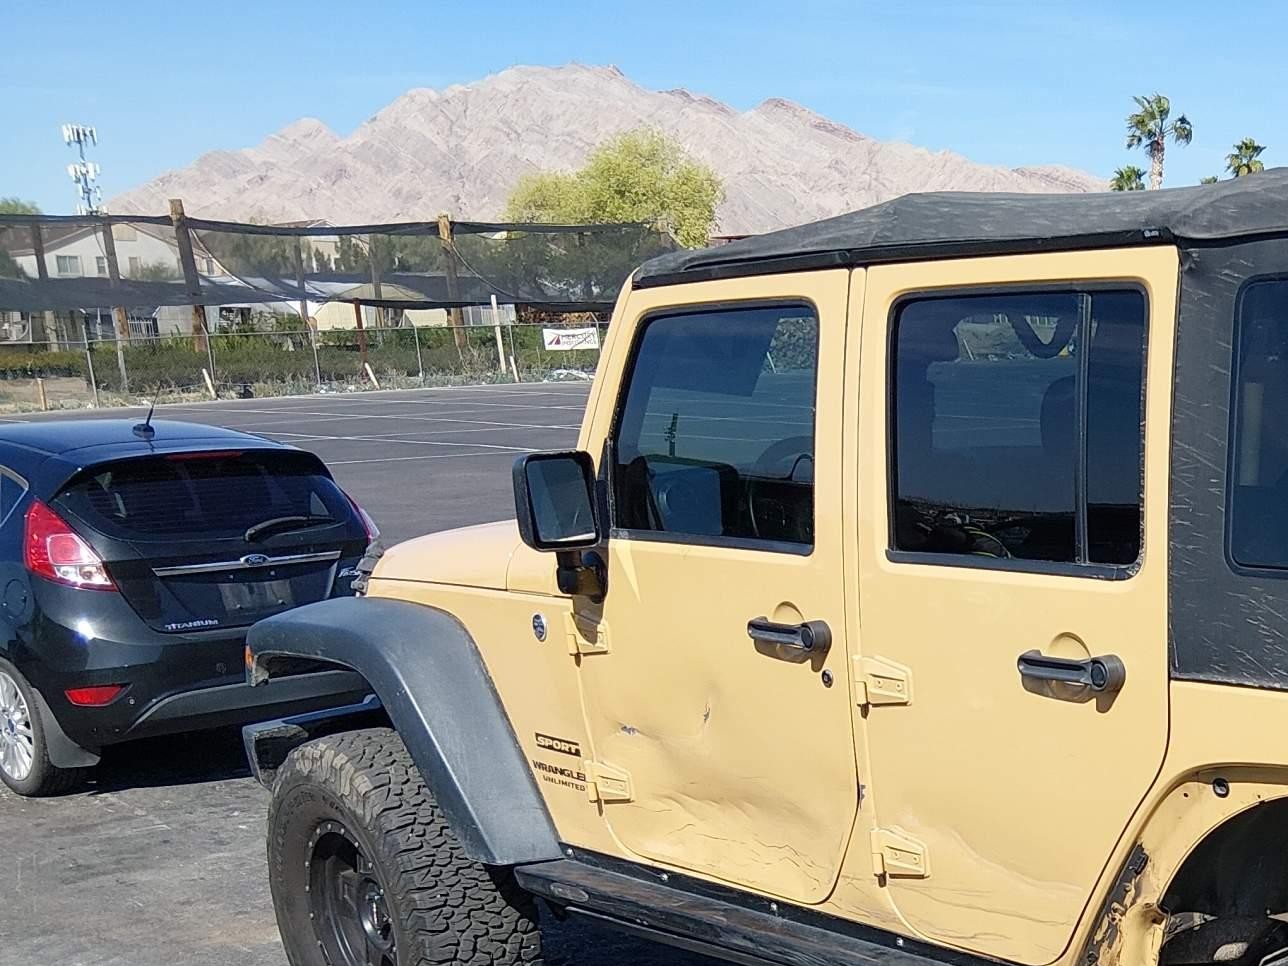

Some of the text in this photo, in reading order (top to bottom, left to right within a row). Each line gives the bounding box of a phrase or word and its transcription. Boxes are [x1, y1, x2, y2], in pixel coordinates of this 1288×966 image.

[164, 619, 218, 630] TITANIUM
[537, 735, 579, 755] SPORT
[532, 760, 586, 782] WRANGLE
[542, 774, 586, 792] UNLIMITED
